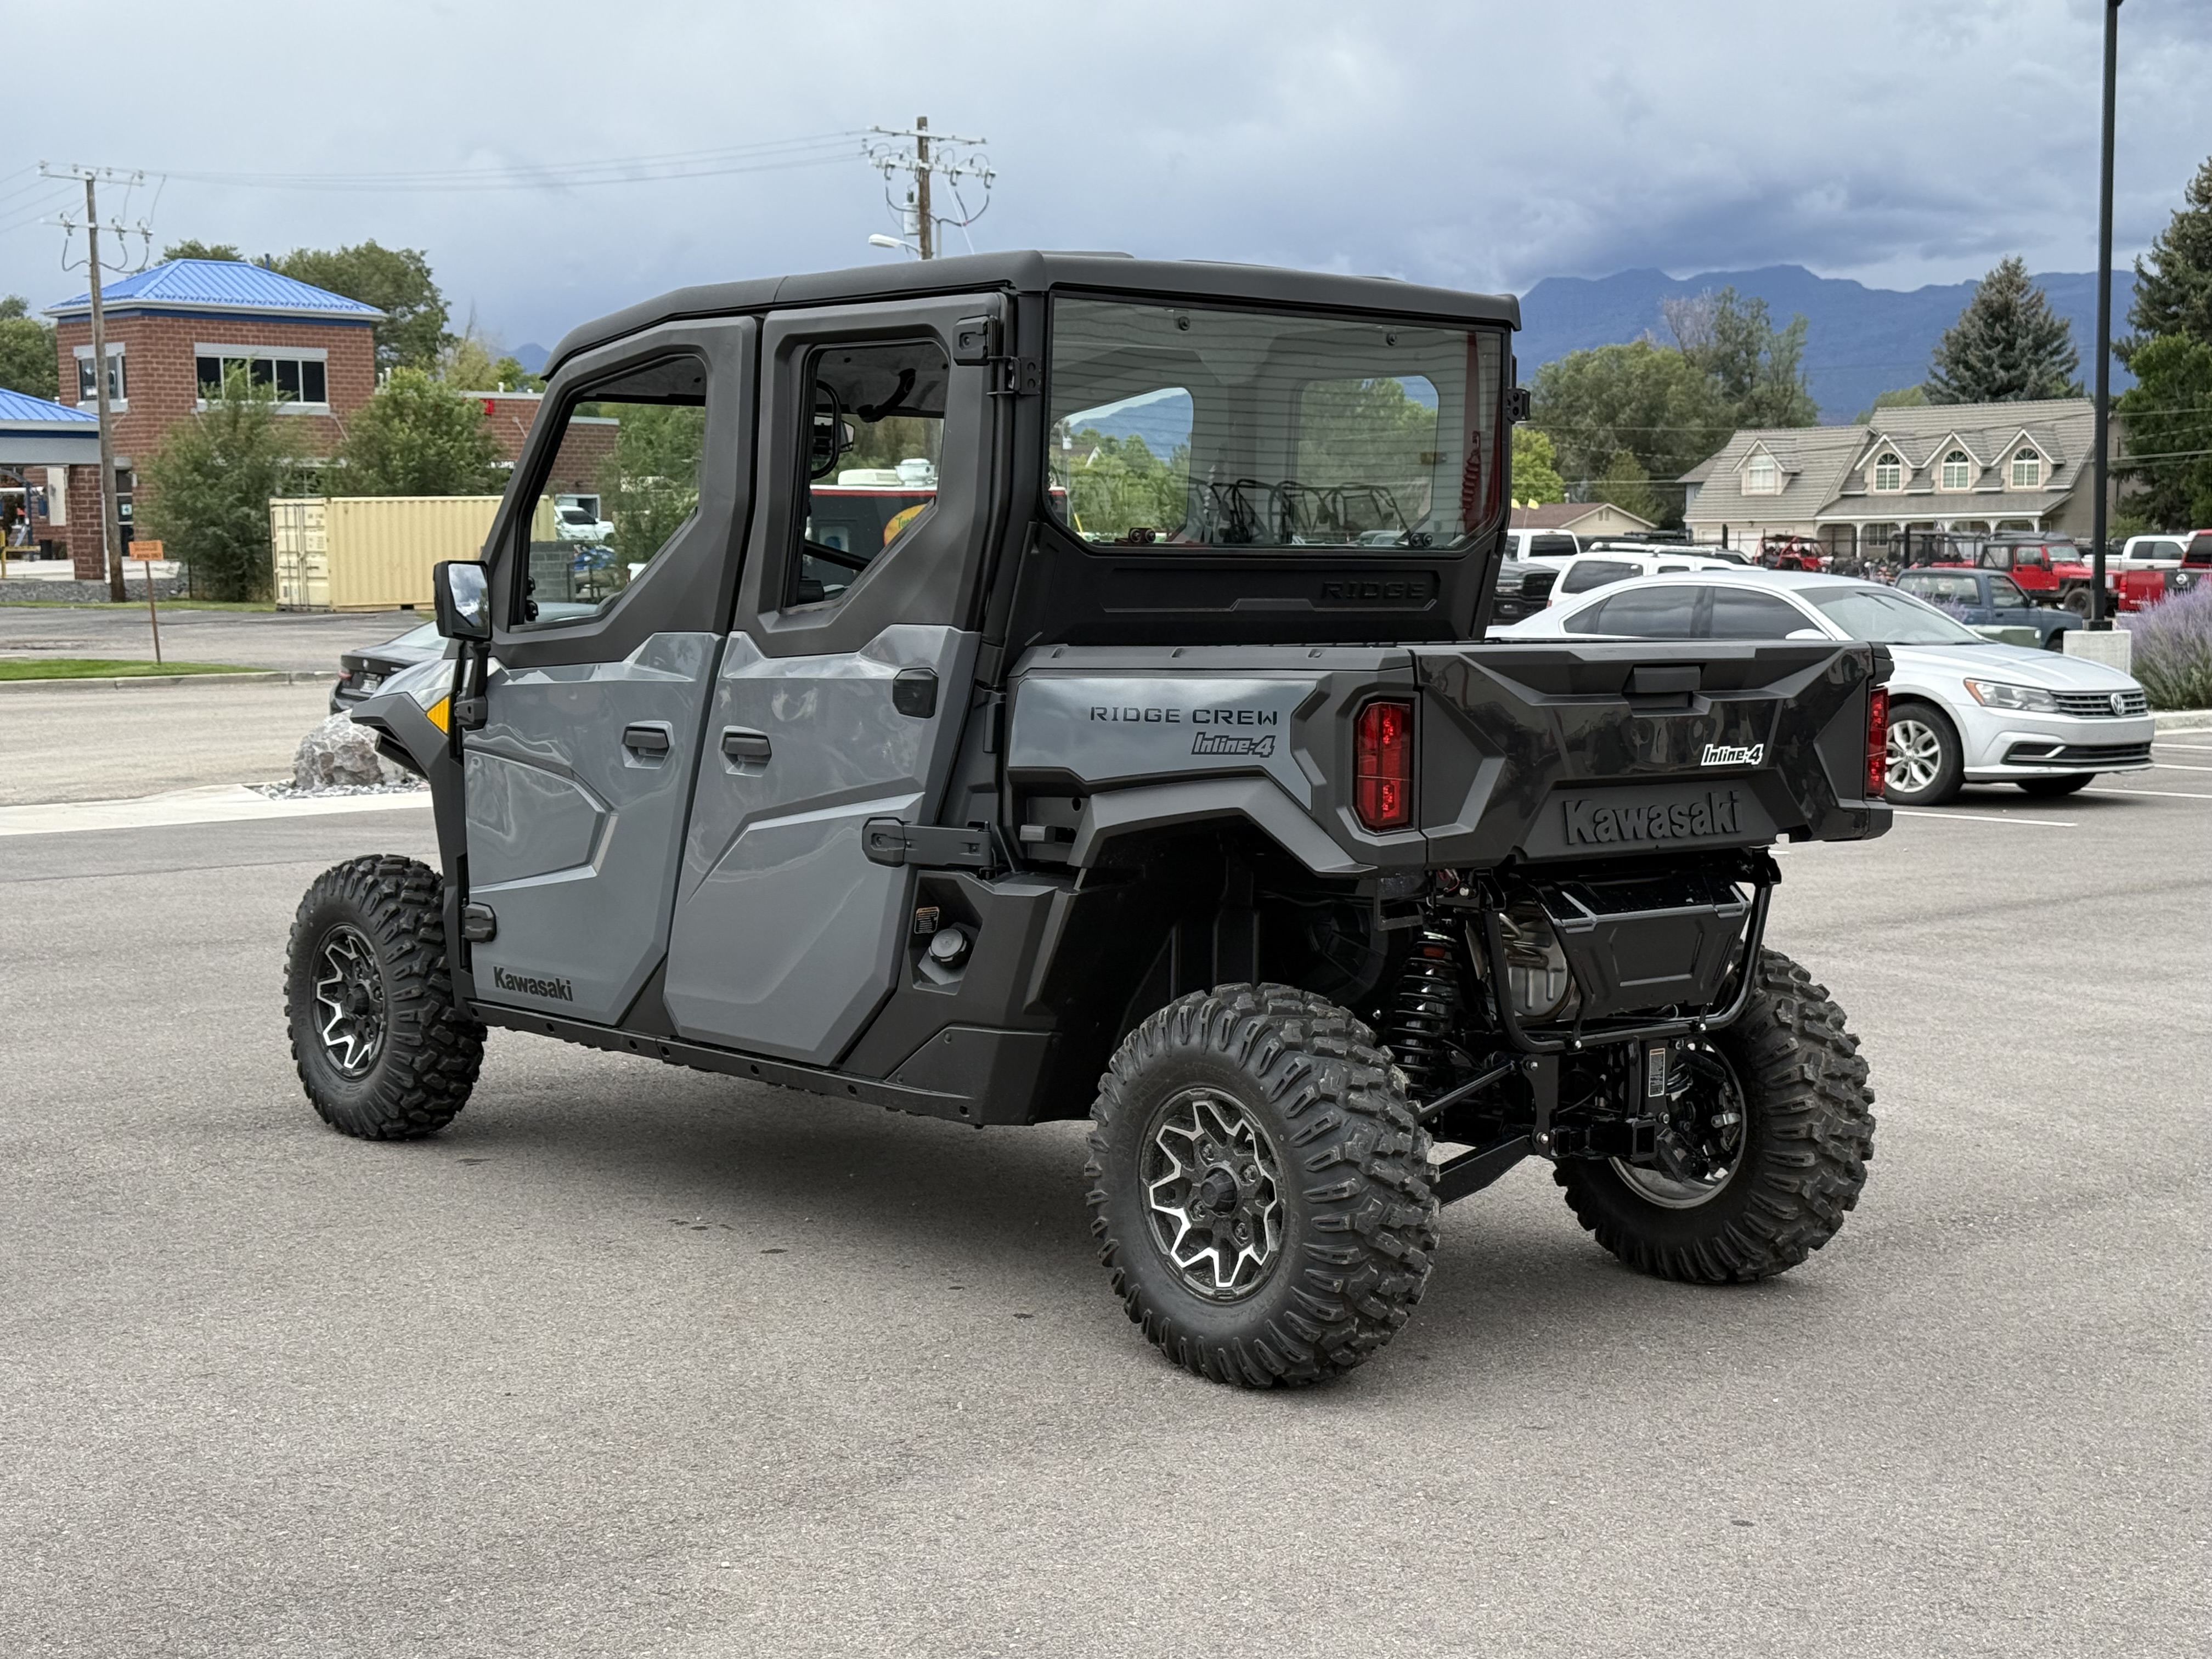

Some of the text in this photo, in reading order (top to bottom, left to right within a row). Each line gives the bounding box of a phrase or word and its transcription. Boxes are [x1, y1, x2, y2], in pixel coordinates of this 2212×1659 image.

[1321, 581, 1426, 599] RIDGE
[1090, 706, 1278, 726] RIDGE CREW
[1191, 732, 1276, 758] Inline-4
[1701, 743, 1764, 766] Inline-4
[1562, 789, 1743, 844] Kawasaki
[493, 966, 574, 1002] Kawasaki
